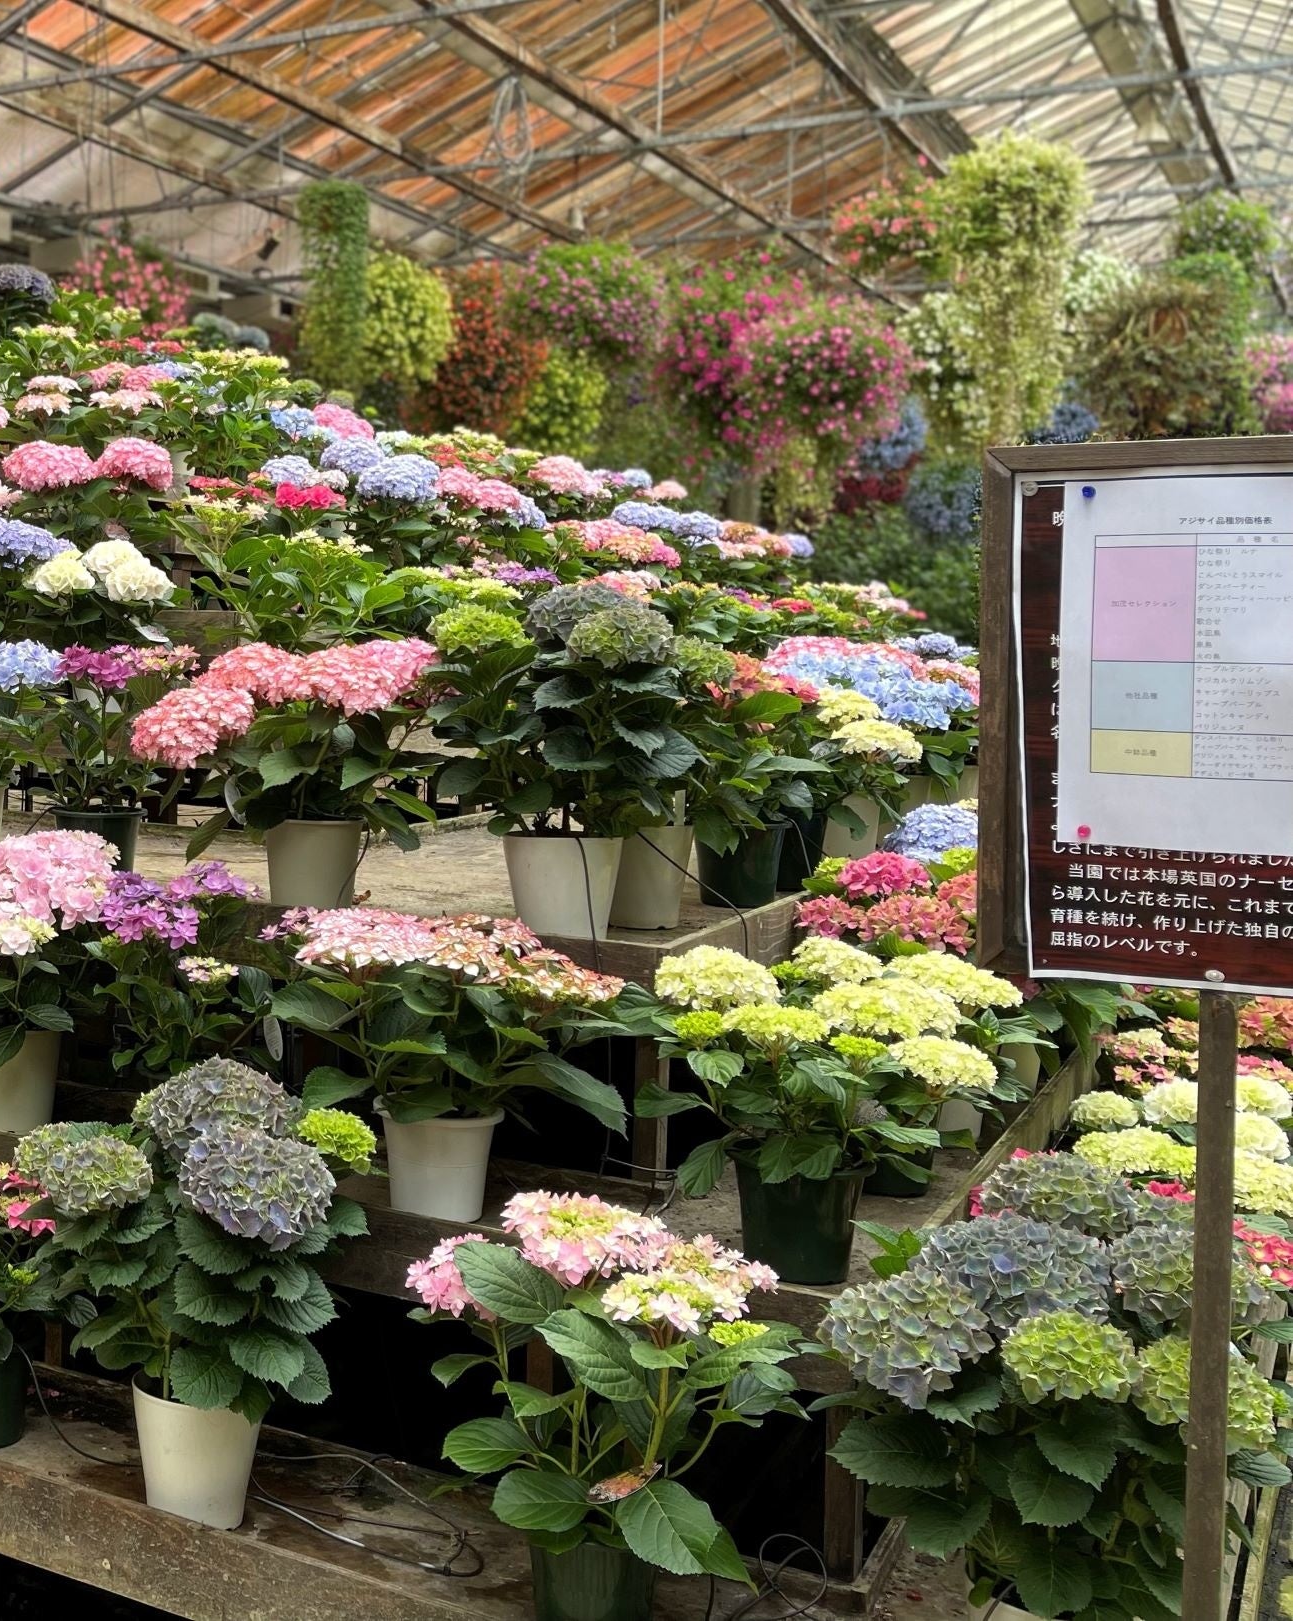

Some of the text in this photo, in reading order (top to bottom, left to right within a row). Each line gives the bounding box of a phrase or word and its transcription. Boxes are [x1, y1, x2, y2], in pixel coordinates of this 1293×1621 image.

[1178, 516, 1274, 526] アジサイ品種別価格表
[1197, 594, 1293, 602] ダンスパーティーハッピ
[1050, 931, 1198, 957] 屈指のレベルです。
